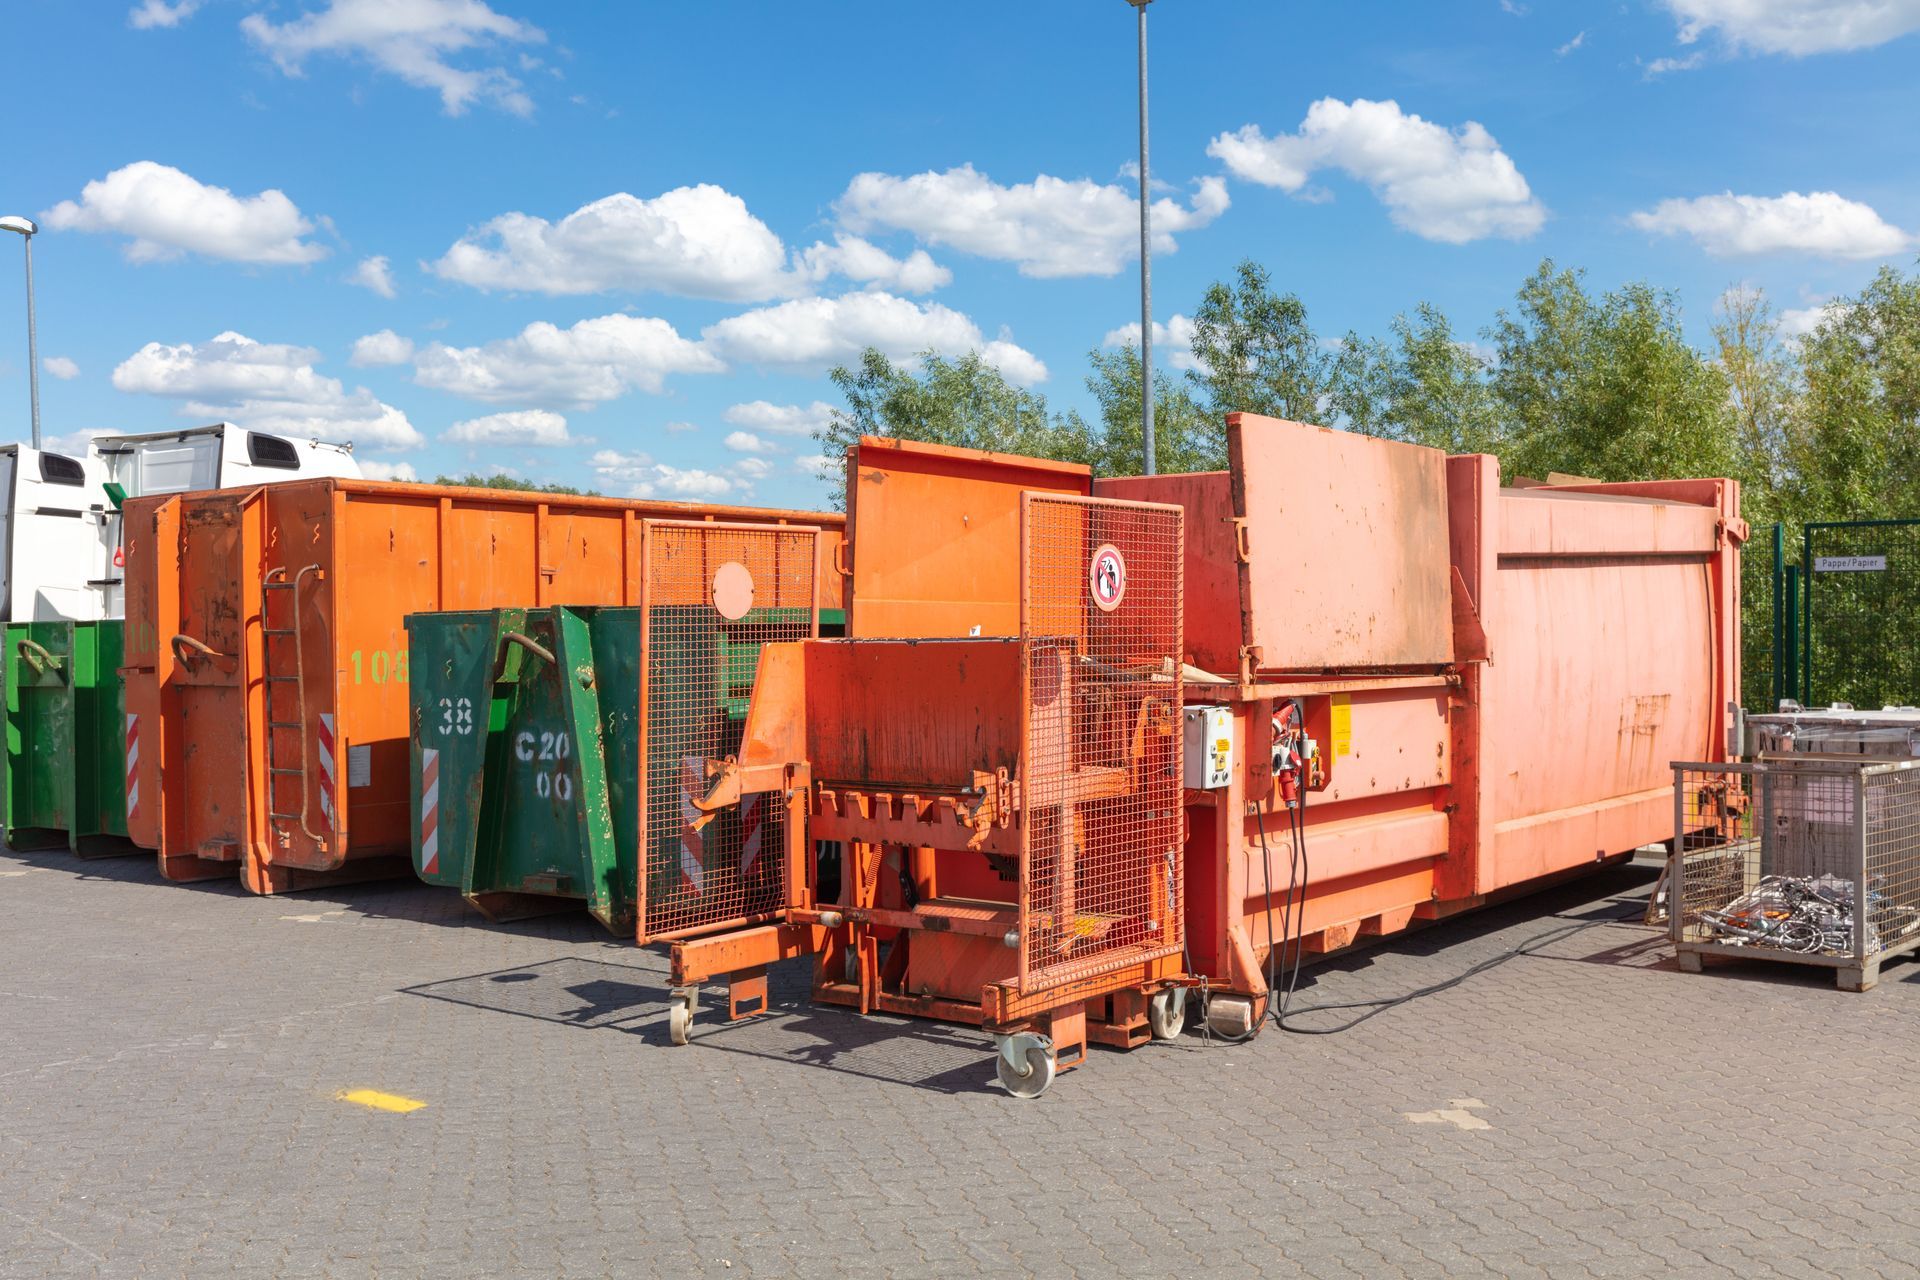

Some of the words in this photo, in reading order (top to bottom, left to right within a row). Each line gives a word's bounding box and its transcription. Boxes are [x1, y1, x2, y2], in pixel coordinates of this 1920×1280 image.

[1822, 558, 1878, 568] Pappe/Papier
[351, 650, 409, 684] 108
[438, 698, 472, 735] 38
[515, 732, 570, 761] C20
[536, 771, 572, 800] 00
